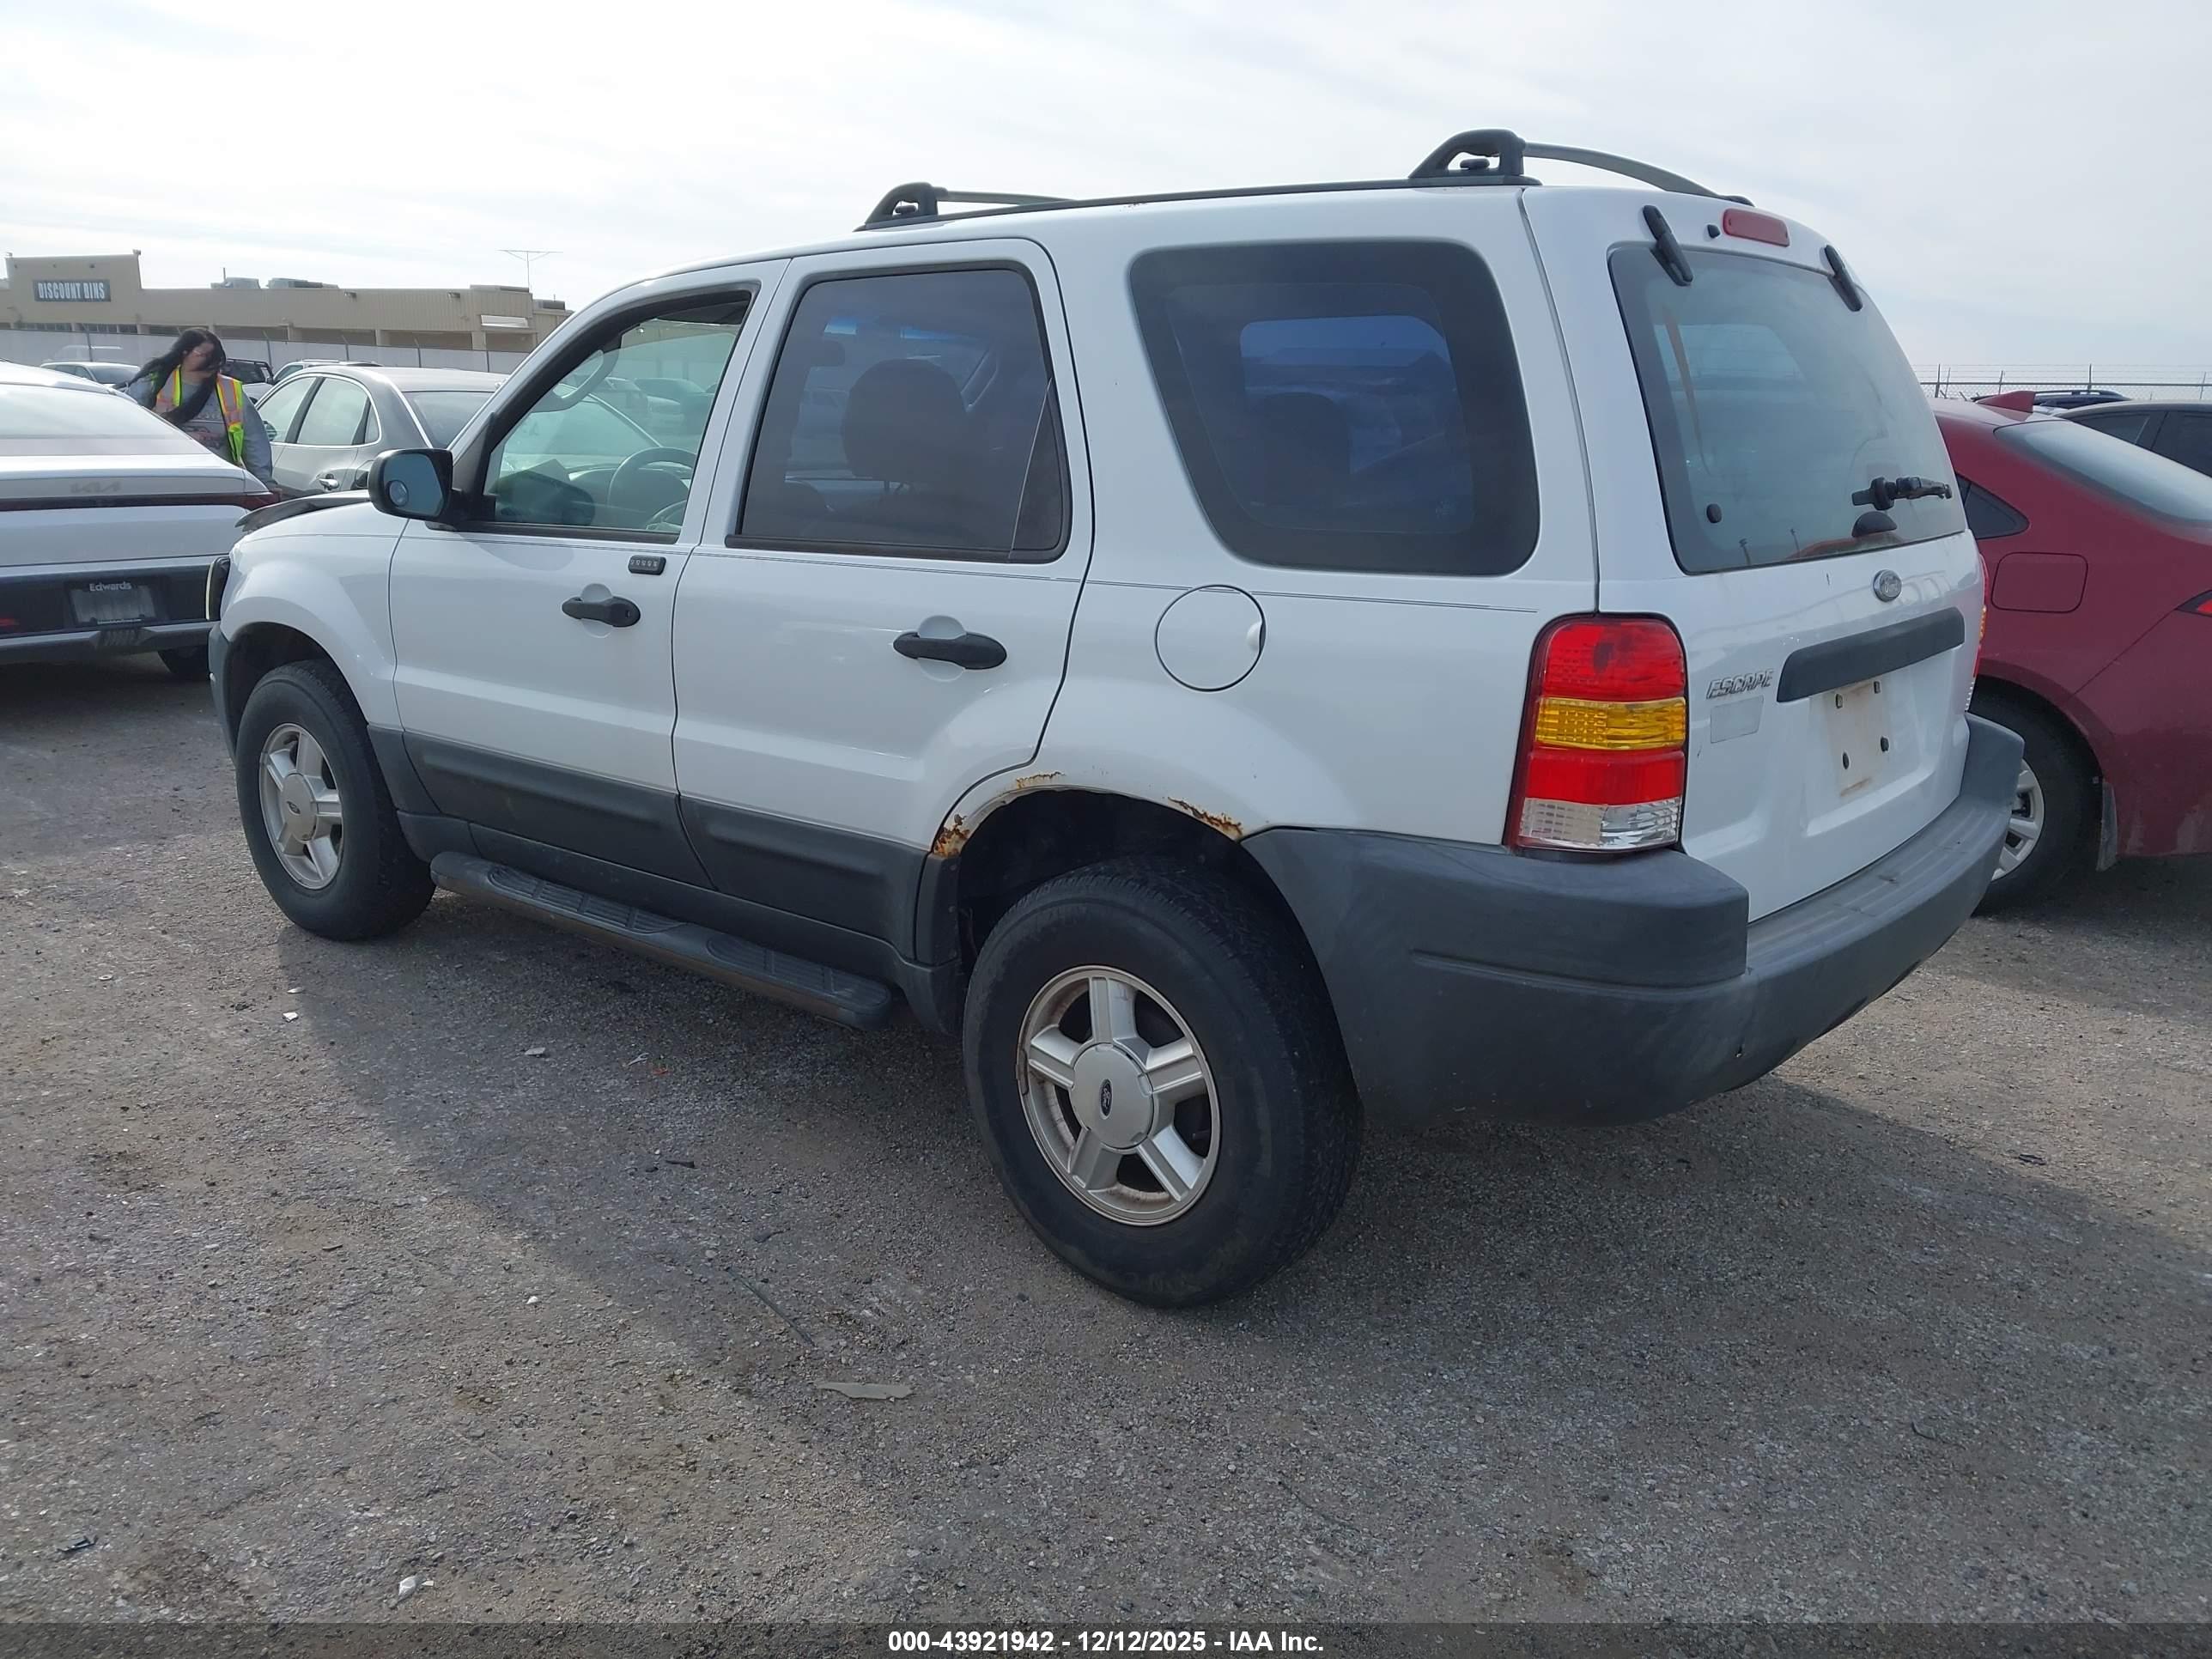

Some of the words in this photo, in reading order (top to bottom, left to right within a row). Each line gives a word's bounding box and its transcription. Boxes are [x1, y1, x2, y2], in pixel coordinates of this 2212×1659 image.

[38, 282, 82, 300] DISCOUNT
[83, 282, 106, 300] BINS
[89, 581, 131, 592] Edwards
[1705, 668, 1774, 700] ESCAPE
